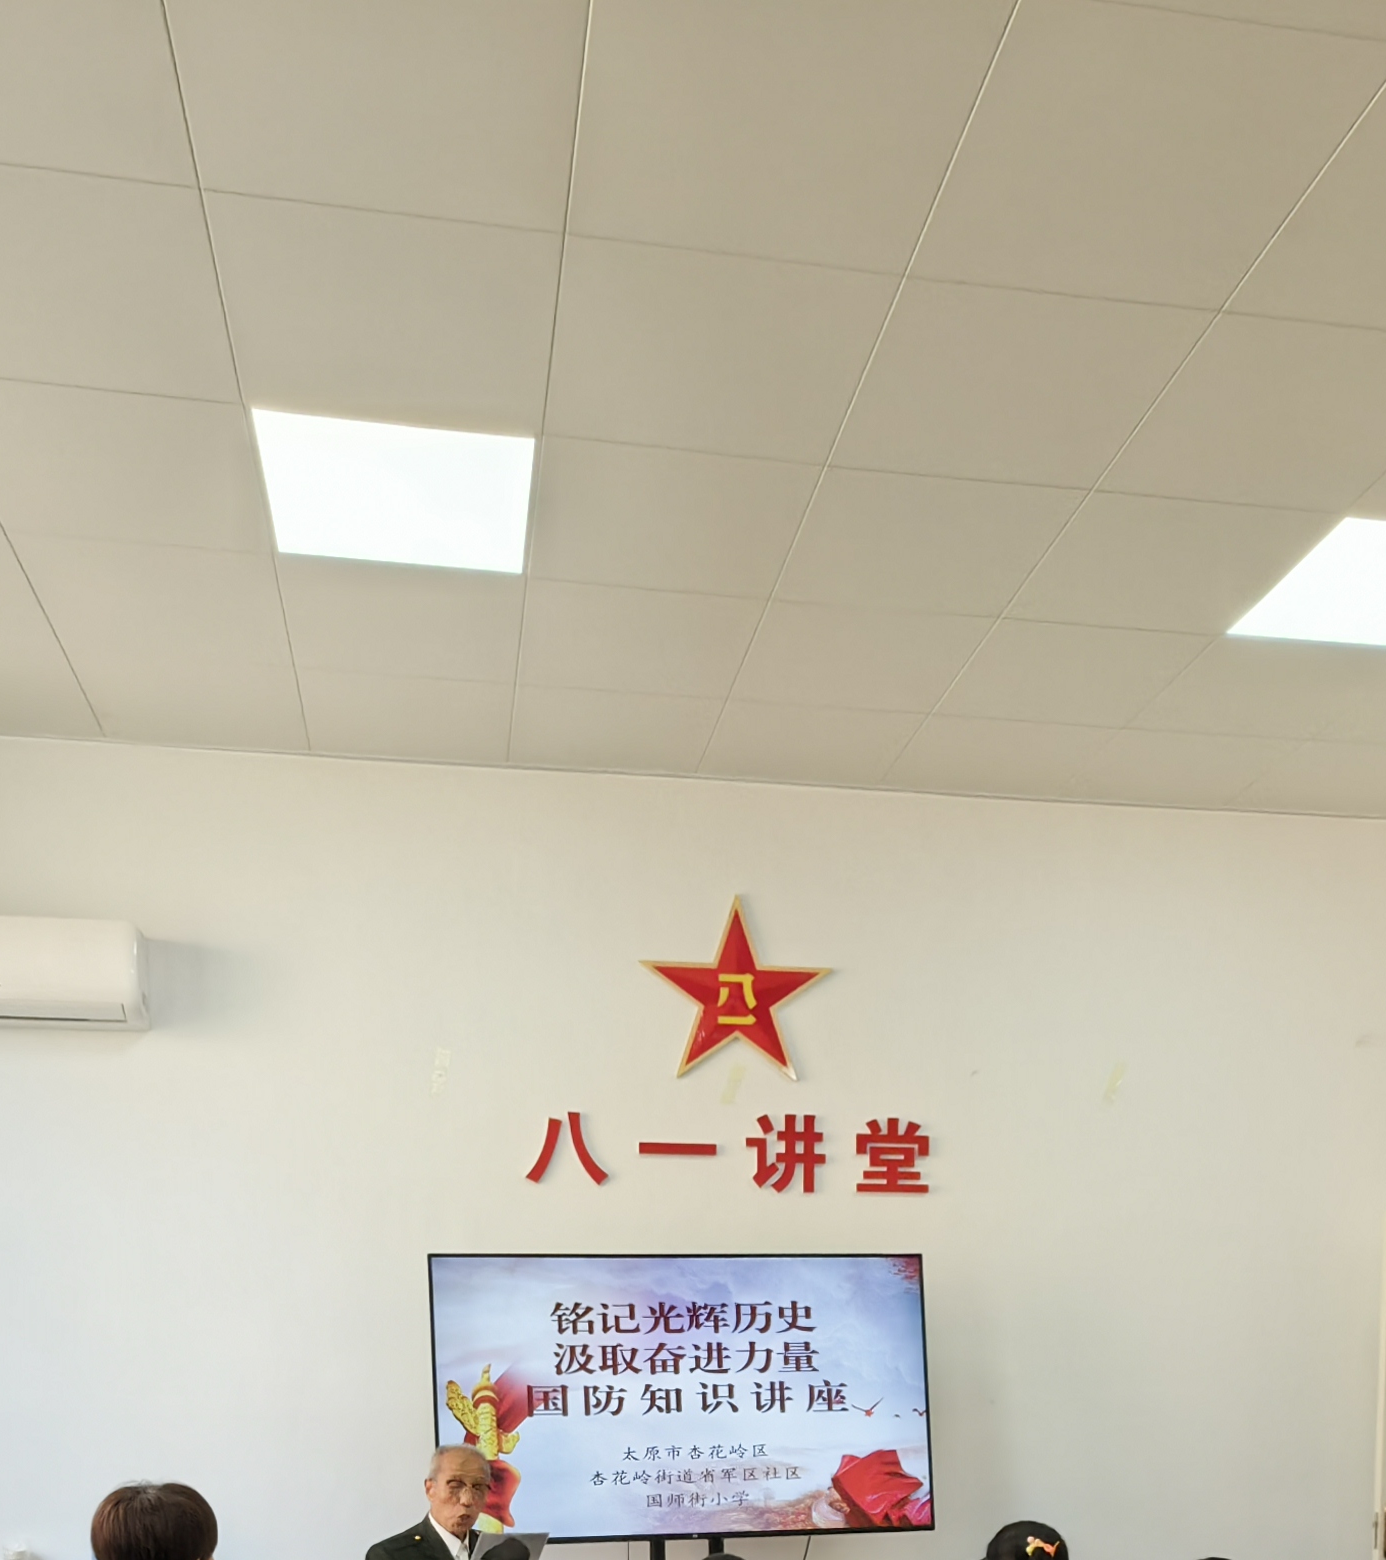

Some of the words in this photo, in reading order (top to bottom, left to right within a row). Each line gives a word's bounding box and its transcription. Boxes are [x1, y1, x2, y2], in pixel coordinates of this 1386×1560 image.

[525, 1110, 930, 1194] 八一讲堂
[550, 1300, 817, 1335] 铭记光辉历史
[553, 1341, 820, 1376] 汲取奋进力量
[526, 1379, 849, 1417] 国防知识讲座
[622, 1443, 769, 1462] 太原市杏花岭区
[589, 1465, 803, 1486] 杏花岭街道省军区社区
[646, 1490, 750, 1508] 国师街小学
